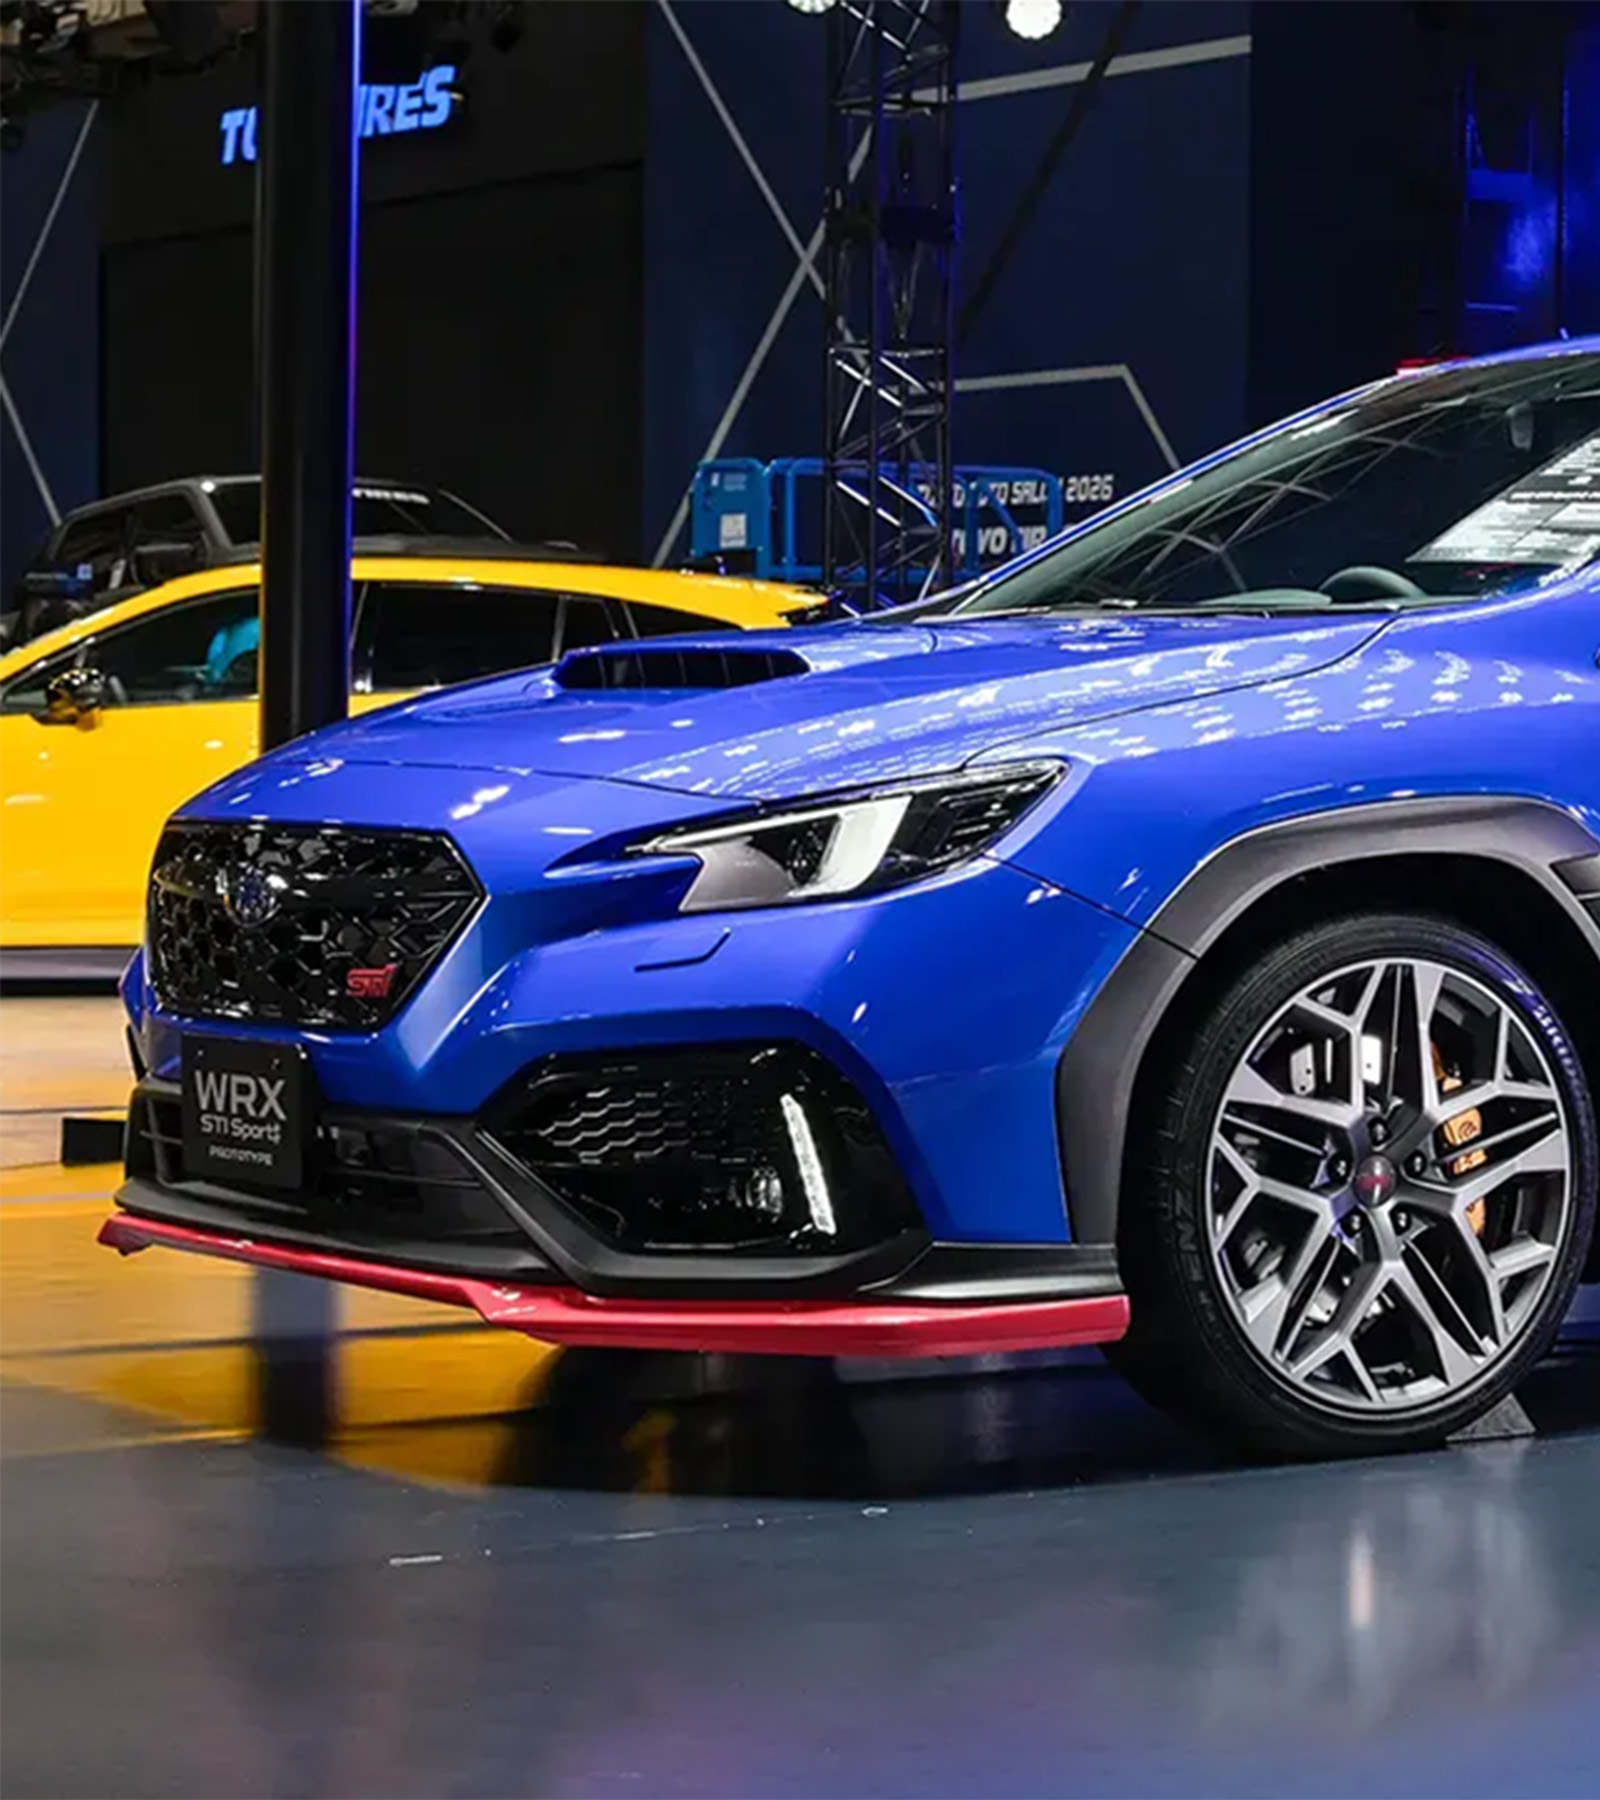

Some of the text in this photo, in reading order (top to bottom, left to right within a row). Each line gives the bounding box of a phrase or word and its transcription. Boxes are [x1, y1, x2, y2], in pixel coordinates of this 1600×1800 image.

[357, 65, 456, 137] IRES
[1065, 474, 1114, 502] 2026
[194, 1069, 287, 1121] WRX
[201, 1113, 229, 1134] STI
[208, 1145, 273, 1166] PROTOTYPE
